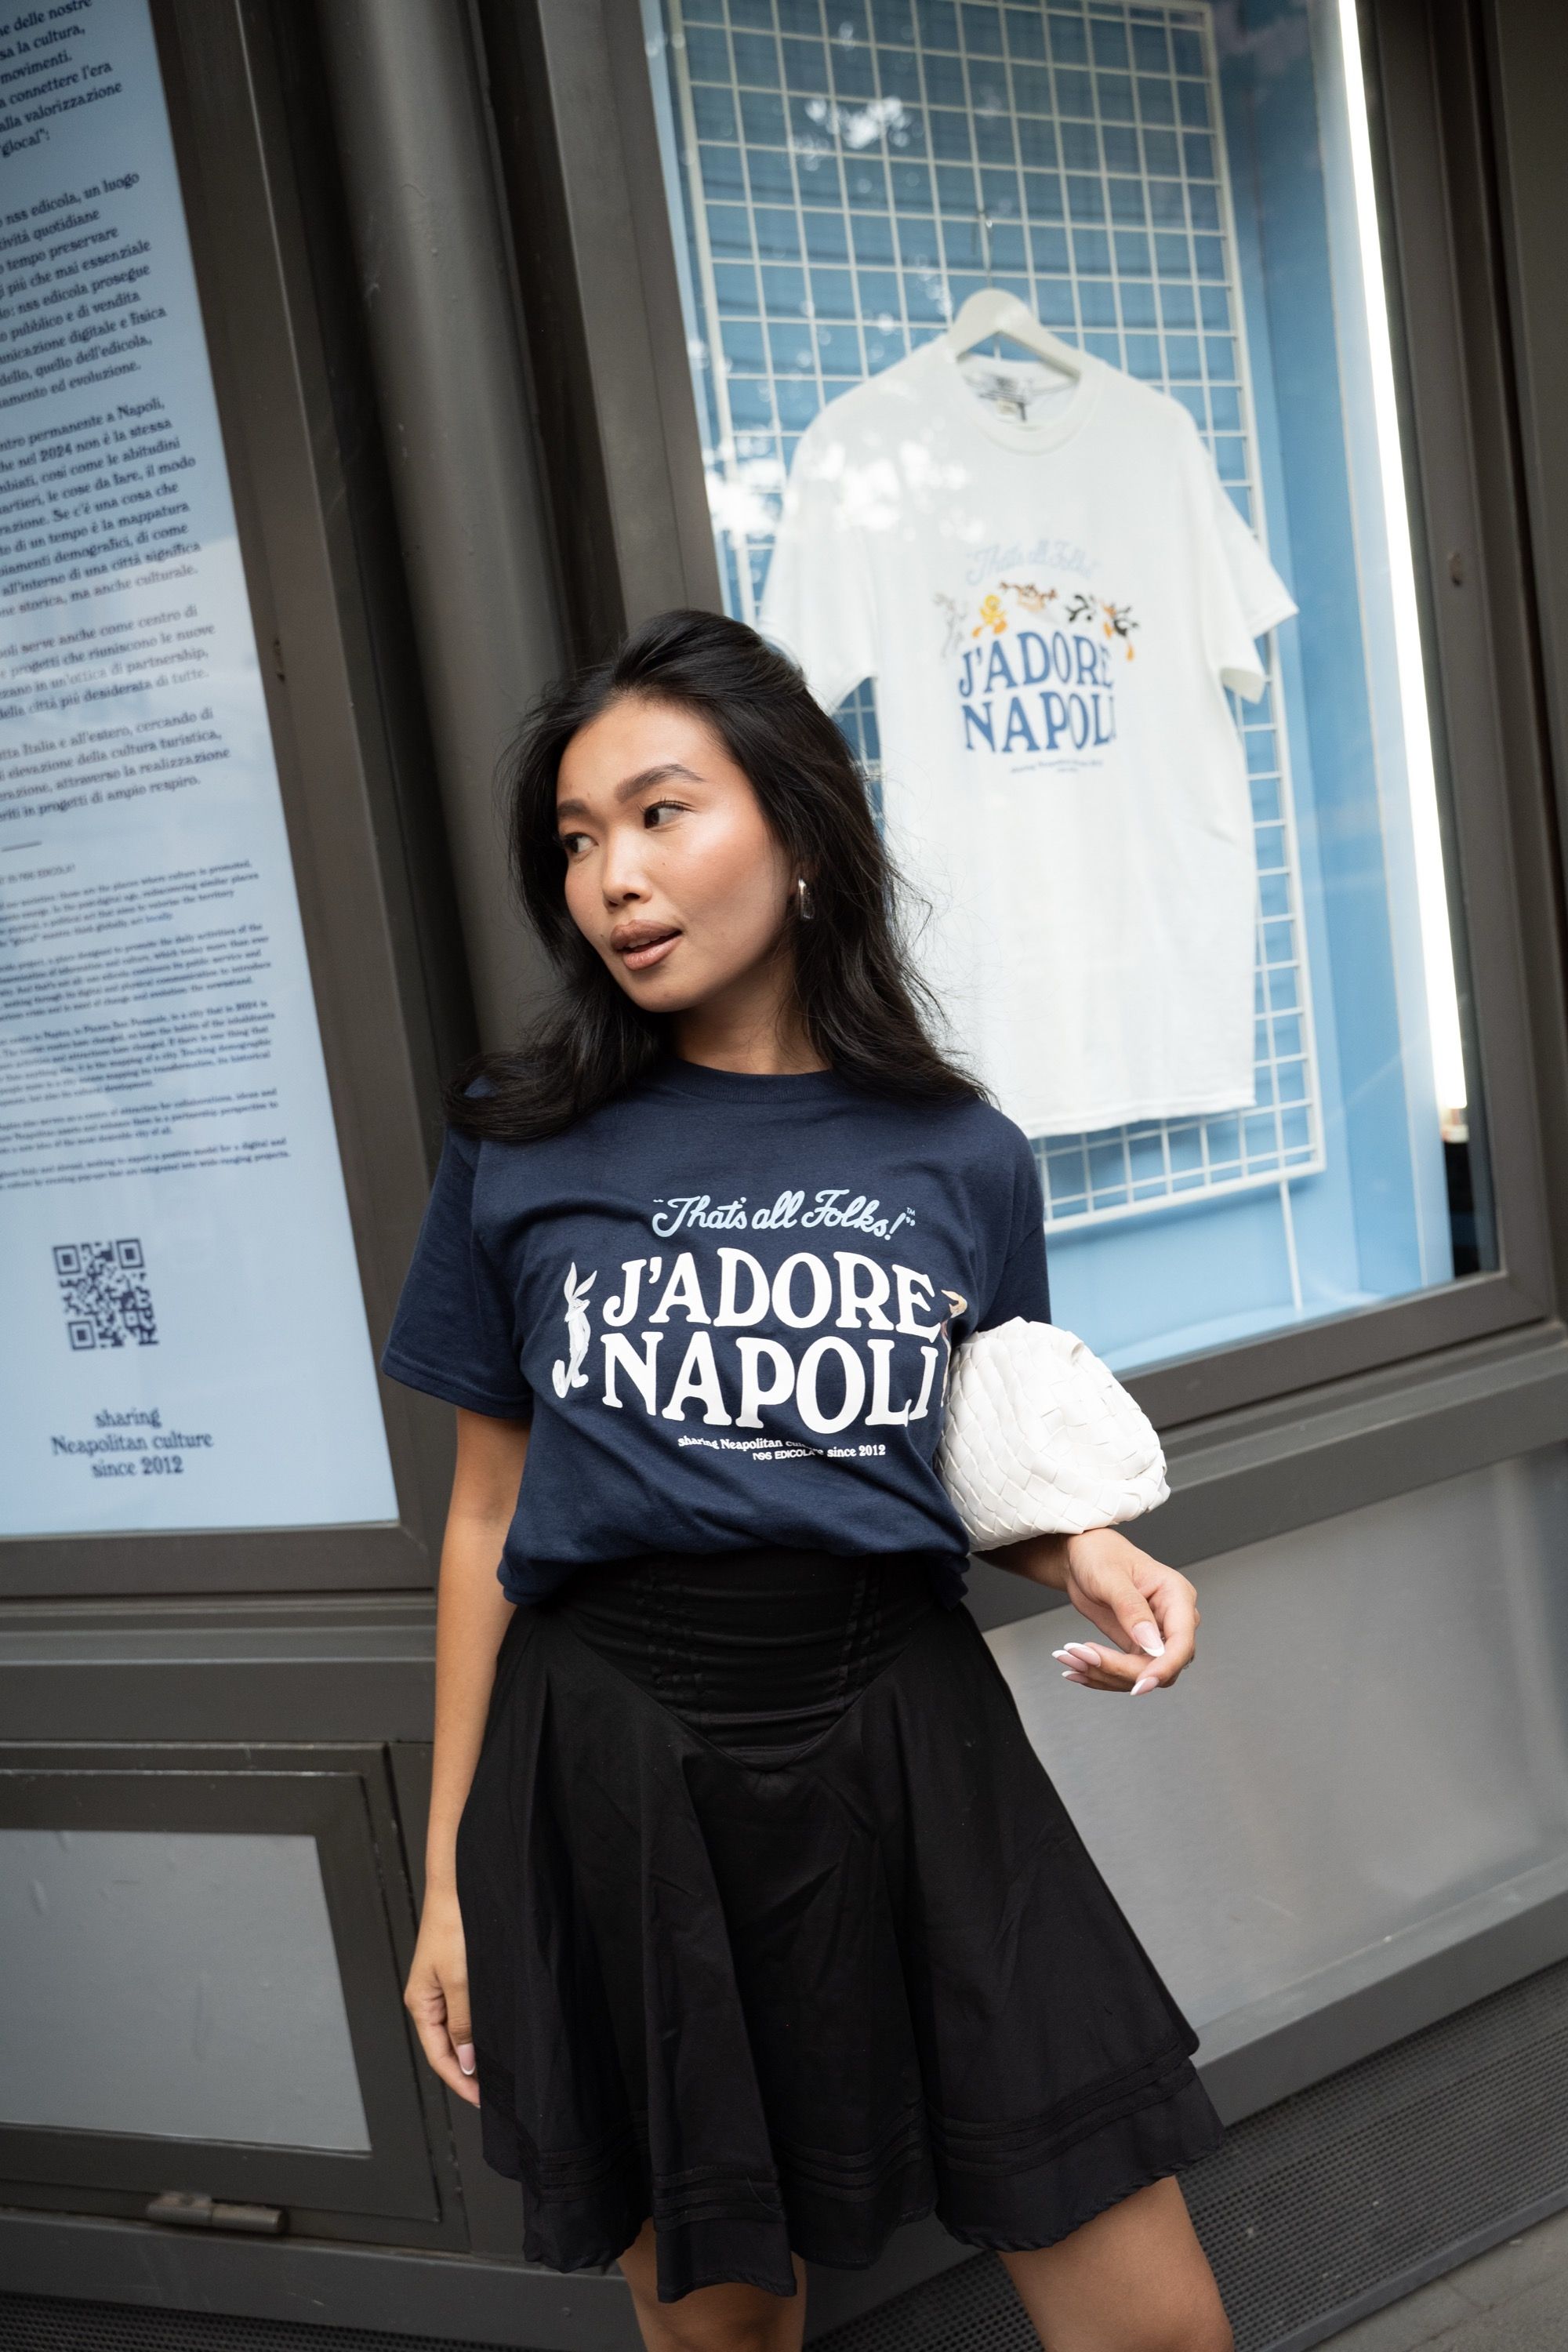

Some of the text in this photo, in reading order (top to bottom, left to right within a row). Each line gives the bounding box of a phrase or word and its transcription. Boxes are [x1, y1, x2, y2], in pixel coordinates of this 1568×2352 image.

[752, 1190, 805, 1230] all
[602, 1247, 941, 1343] J'ADORE
[601, 1330, 938, 1434] NAPOLI
[93, 1408, 163, 1429] sharing
[50, 1431, 213, 1457] Neapolitan culture
[720, 1438, 782, 1451] Neapolitan
[827, 1446, 856, 1457] since
[858, 1445, 886, 1457] 2012
[92, 1454, 185, 1478] since 2012
